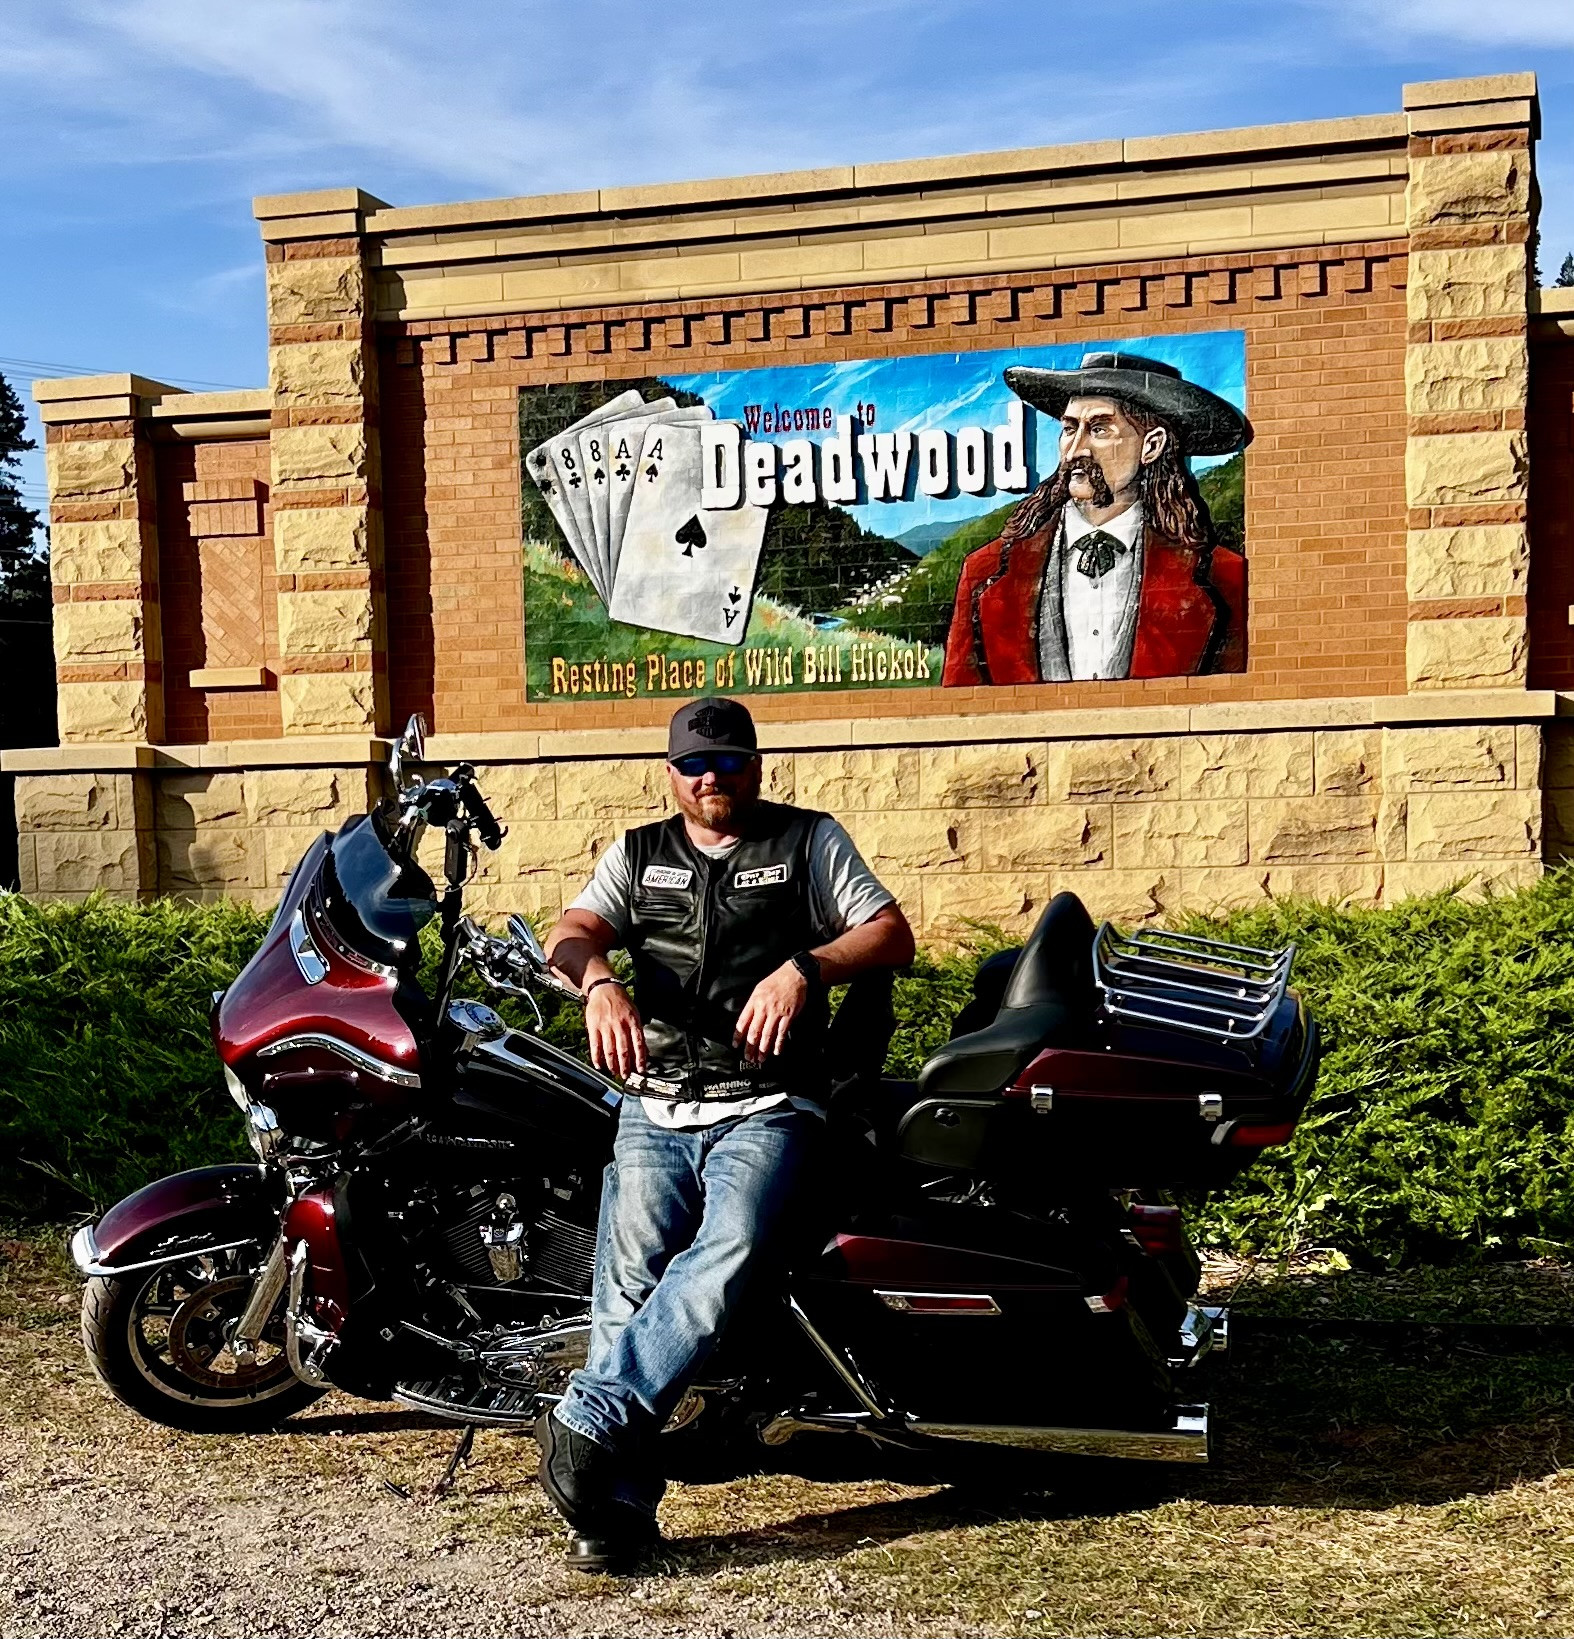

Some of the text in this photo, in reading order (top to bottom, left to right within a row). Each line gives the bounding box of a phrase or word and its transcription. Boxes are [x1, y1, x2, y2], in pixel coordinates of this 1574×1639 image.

[743, 400, 876, 434] Welcome to
[561, 438, 664, 470] 8 8 A A
[700, 400, 1032, 511] Deadwood
[722, 608, 741, 628] A
[551, 640, 930, 698] Resting Place of Wild Bill Hickok
[645, 873, 689, 887] AMERICAN
[703, 1079, 752, 1091] WARNING
